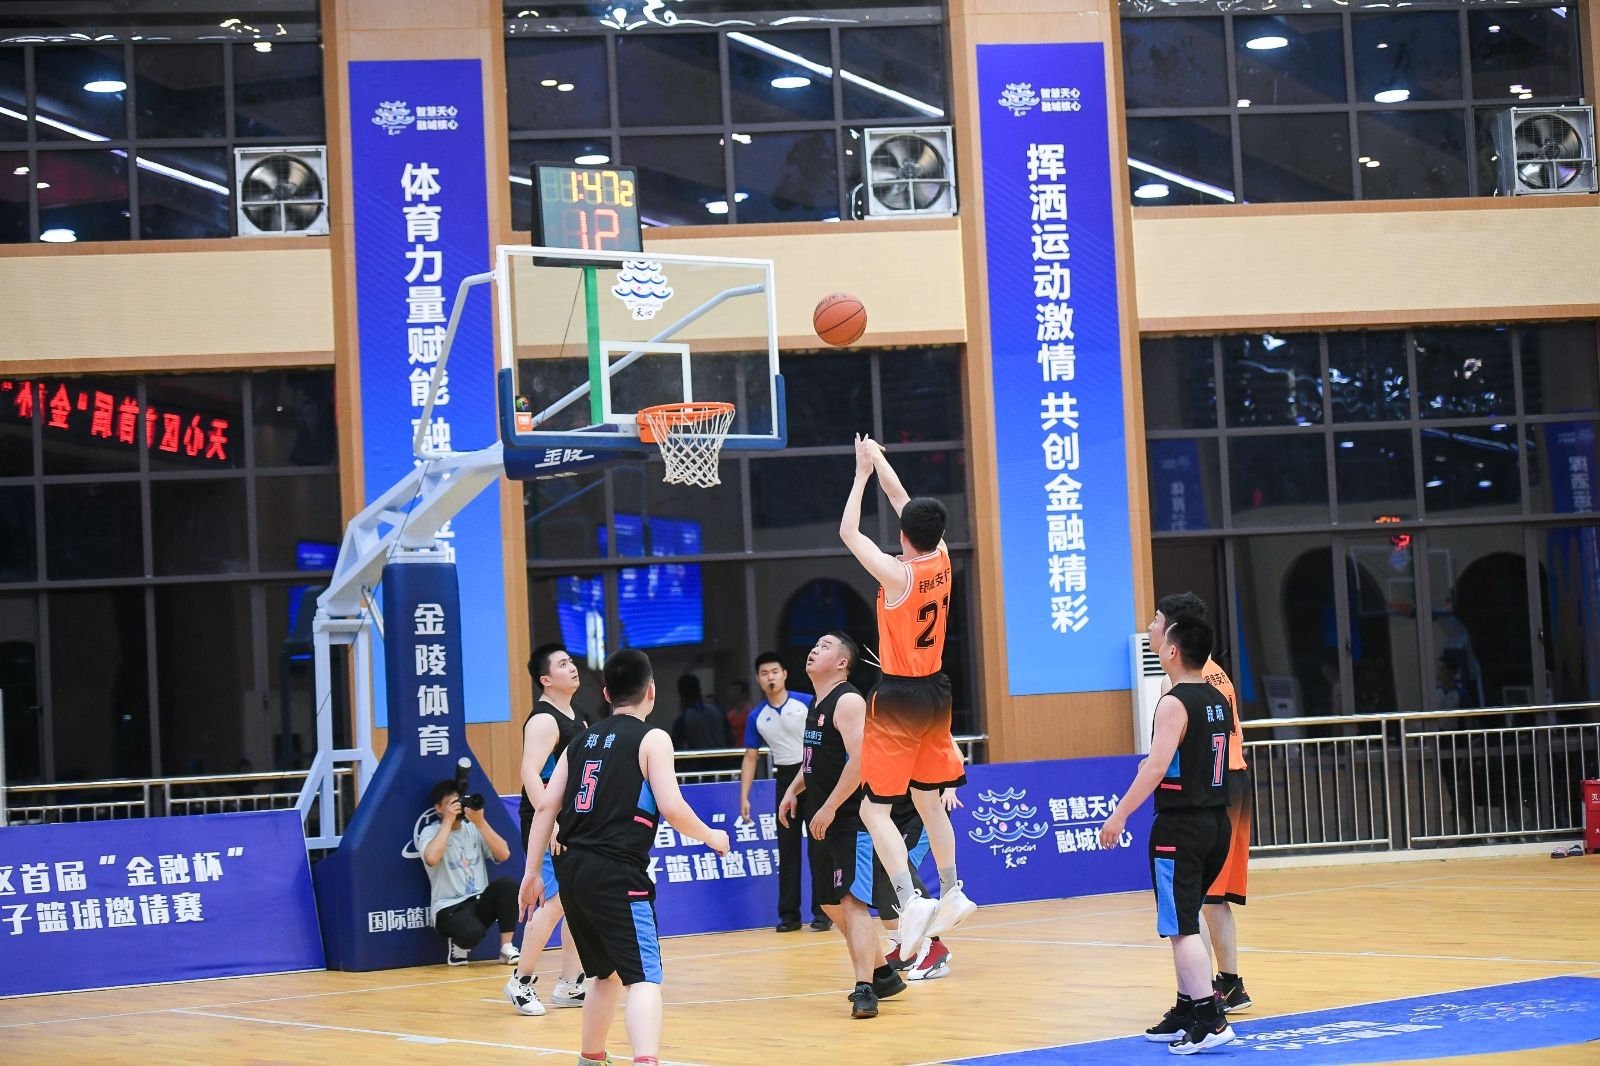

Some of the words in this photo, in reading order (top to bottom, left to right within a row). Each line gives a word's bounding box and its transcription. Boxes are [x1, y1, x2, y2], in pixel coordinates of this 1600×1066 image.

[579, 209, 619, 251] 12
[1027, 143, 1076, 382] 挥洒运动激情
[1040, 391, 1090, 634] 共创金融精彩
[414, 603, 450, 756] 金陵体育
[1212, 733, 1226, 786] 7
[575, 760, 602, 813] 5
[646, 849, 780, 884] 子篮球邀请
[990, 842, 1037, 856] Tianxin
[1005, 854, 1028, 868] 天心
[2, 892, 204, 936] 子篮球邀请赛
